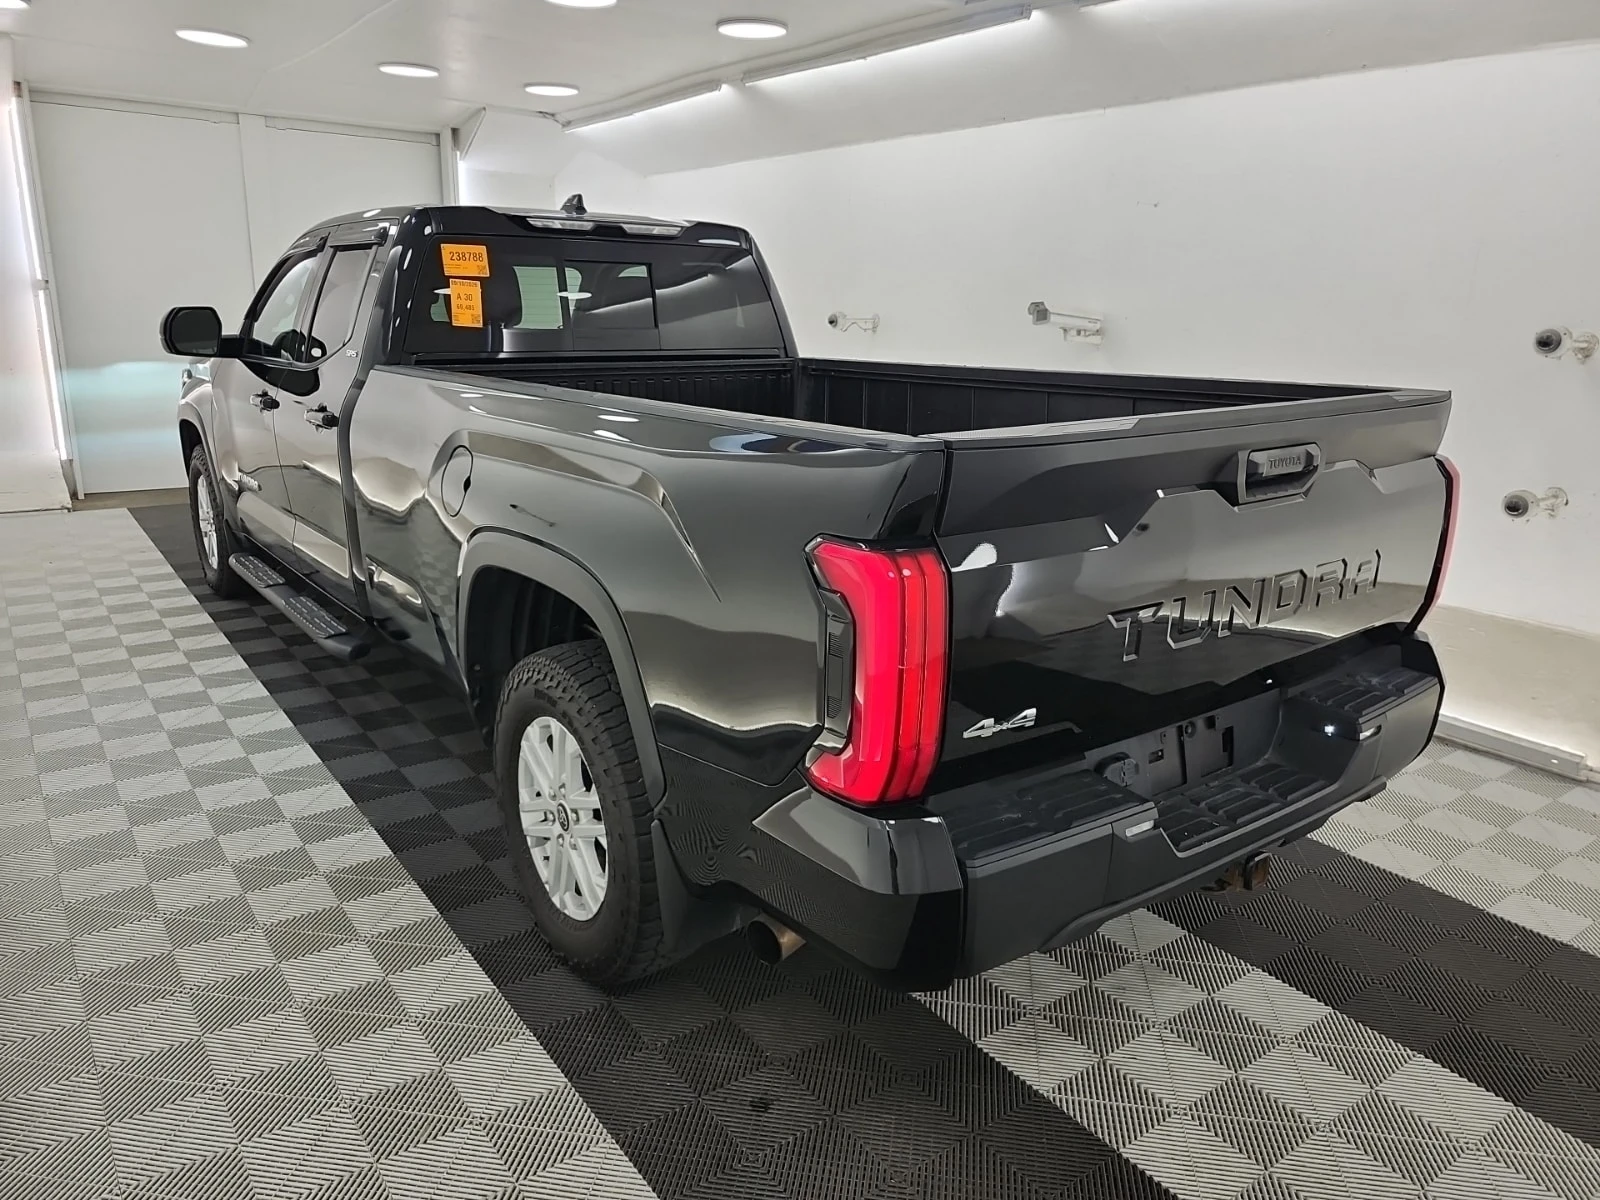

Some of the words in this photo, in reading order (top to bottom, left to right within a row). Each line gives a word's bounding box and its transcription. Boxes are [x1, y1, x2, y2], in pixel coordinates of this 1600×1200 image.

[449, 251, 484, 262] 238788
[456, 293, 462, 301] A
[464, 294, 473, 302] 30
[1268, 455, 1302, 470] TOYOTA
[1107, 548, 1381, 662] TUNDRA
